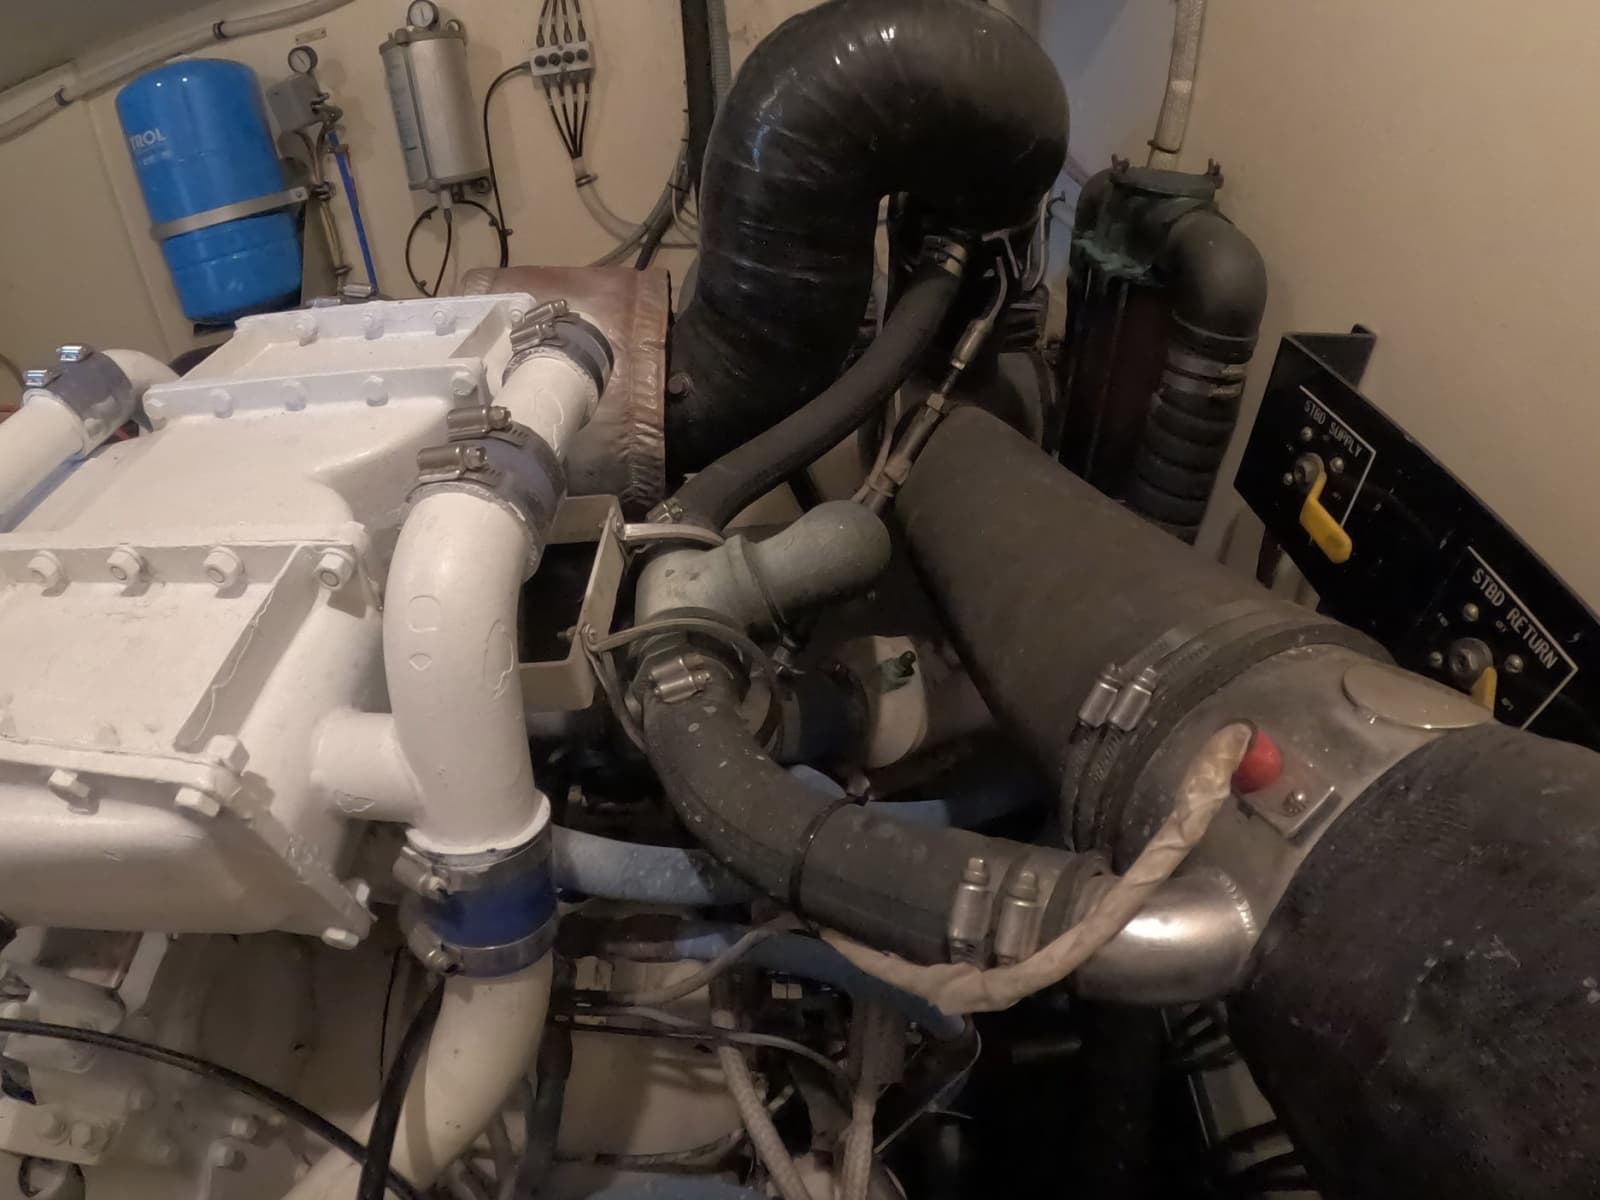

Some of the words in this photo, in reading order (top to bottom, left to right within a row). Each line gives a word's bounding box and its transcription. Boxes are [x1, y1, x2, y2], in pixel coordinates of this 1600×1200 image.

[1303, 399, 1326, 425] STBD
[1328, 421, 1363, 457] SUPPLY
[1472, 567, 1505, 607] STBD
[1506, 607, 1558, 670] RETURN
